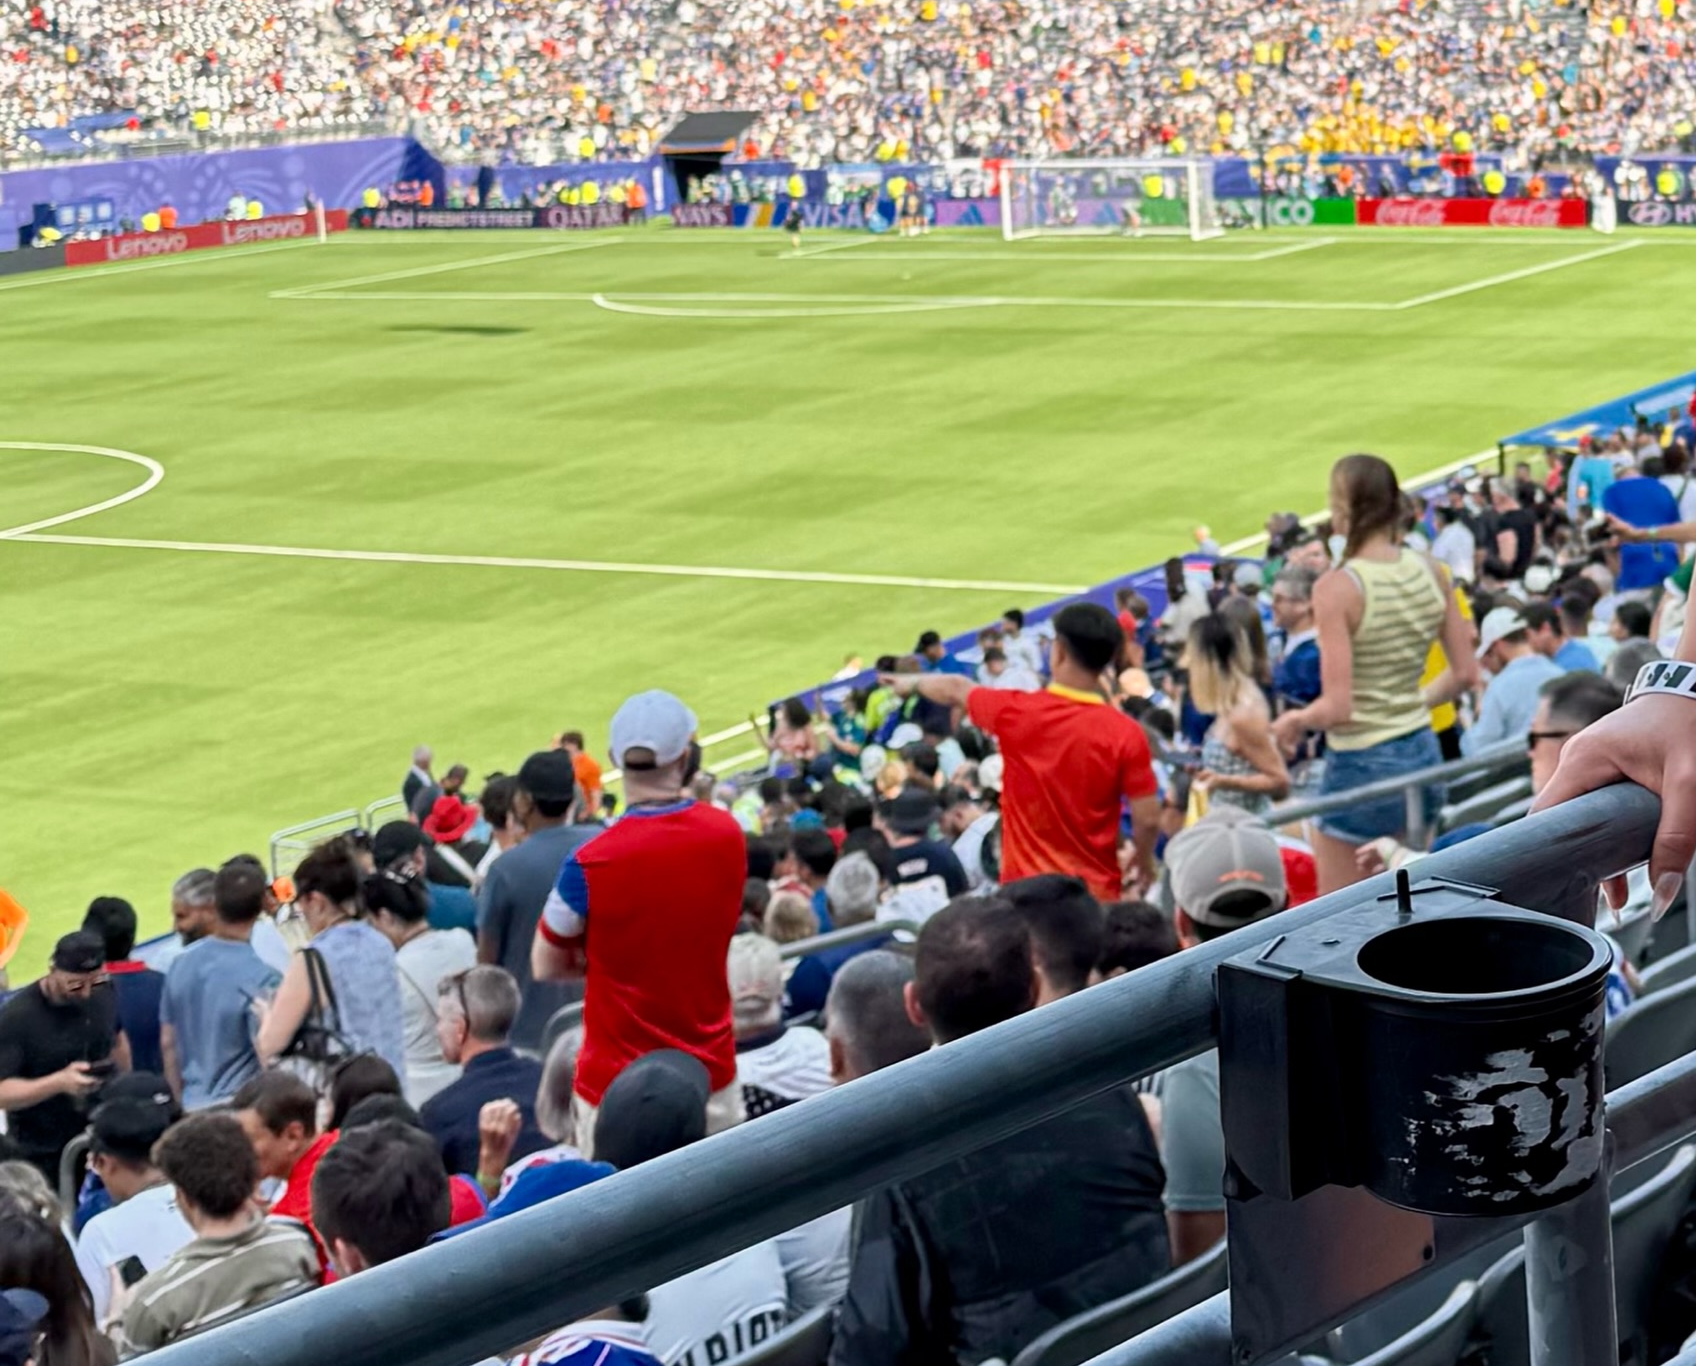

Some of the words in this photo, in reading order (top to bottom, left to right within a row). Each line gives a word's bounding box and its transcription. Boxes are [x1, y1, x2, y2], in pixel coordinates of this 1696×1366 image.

[549, 204, 624, 230] QATAR
[803, 201, 863, 227] VISA
[222, 217, 305, 245] Lenovo
[106, 231, 188, 261] Lenovo
